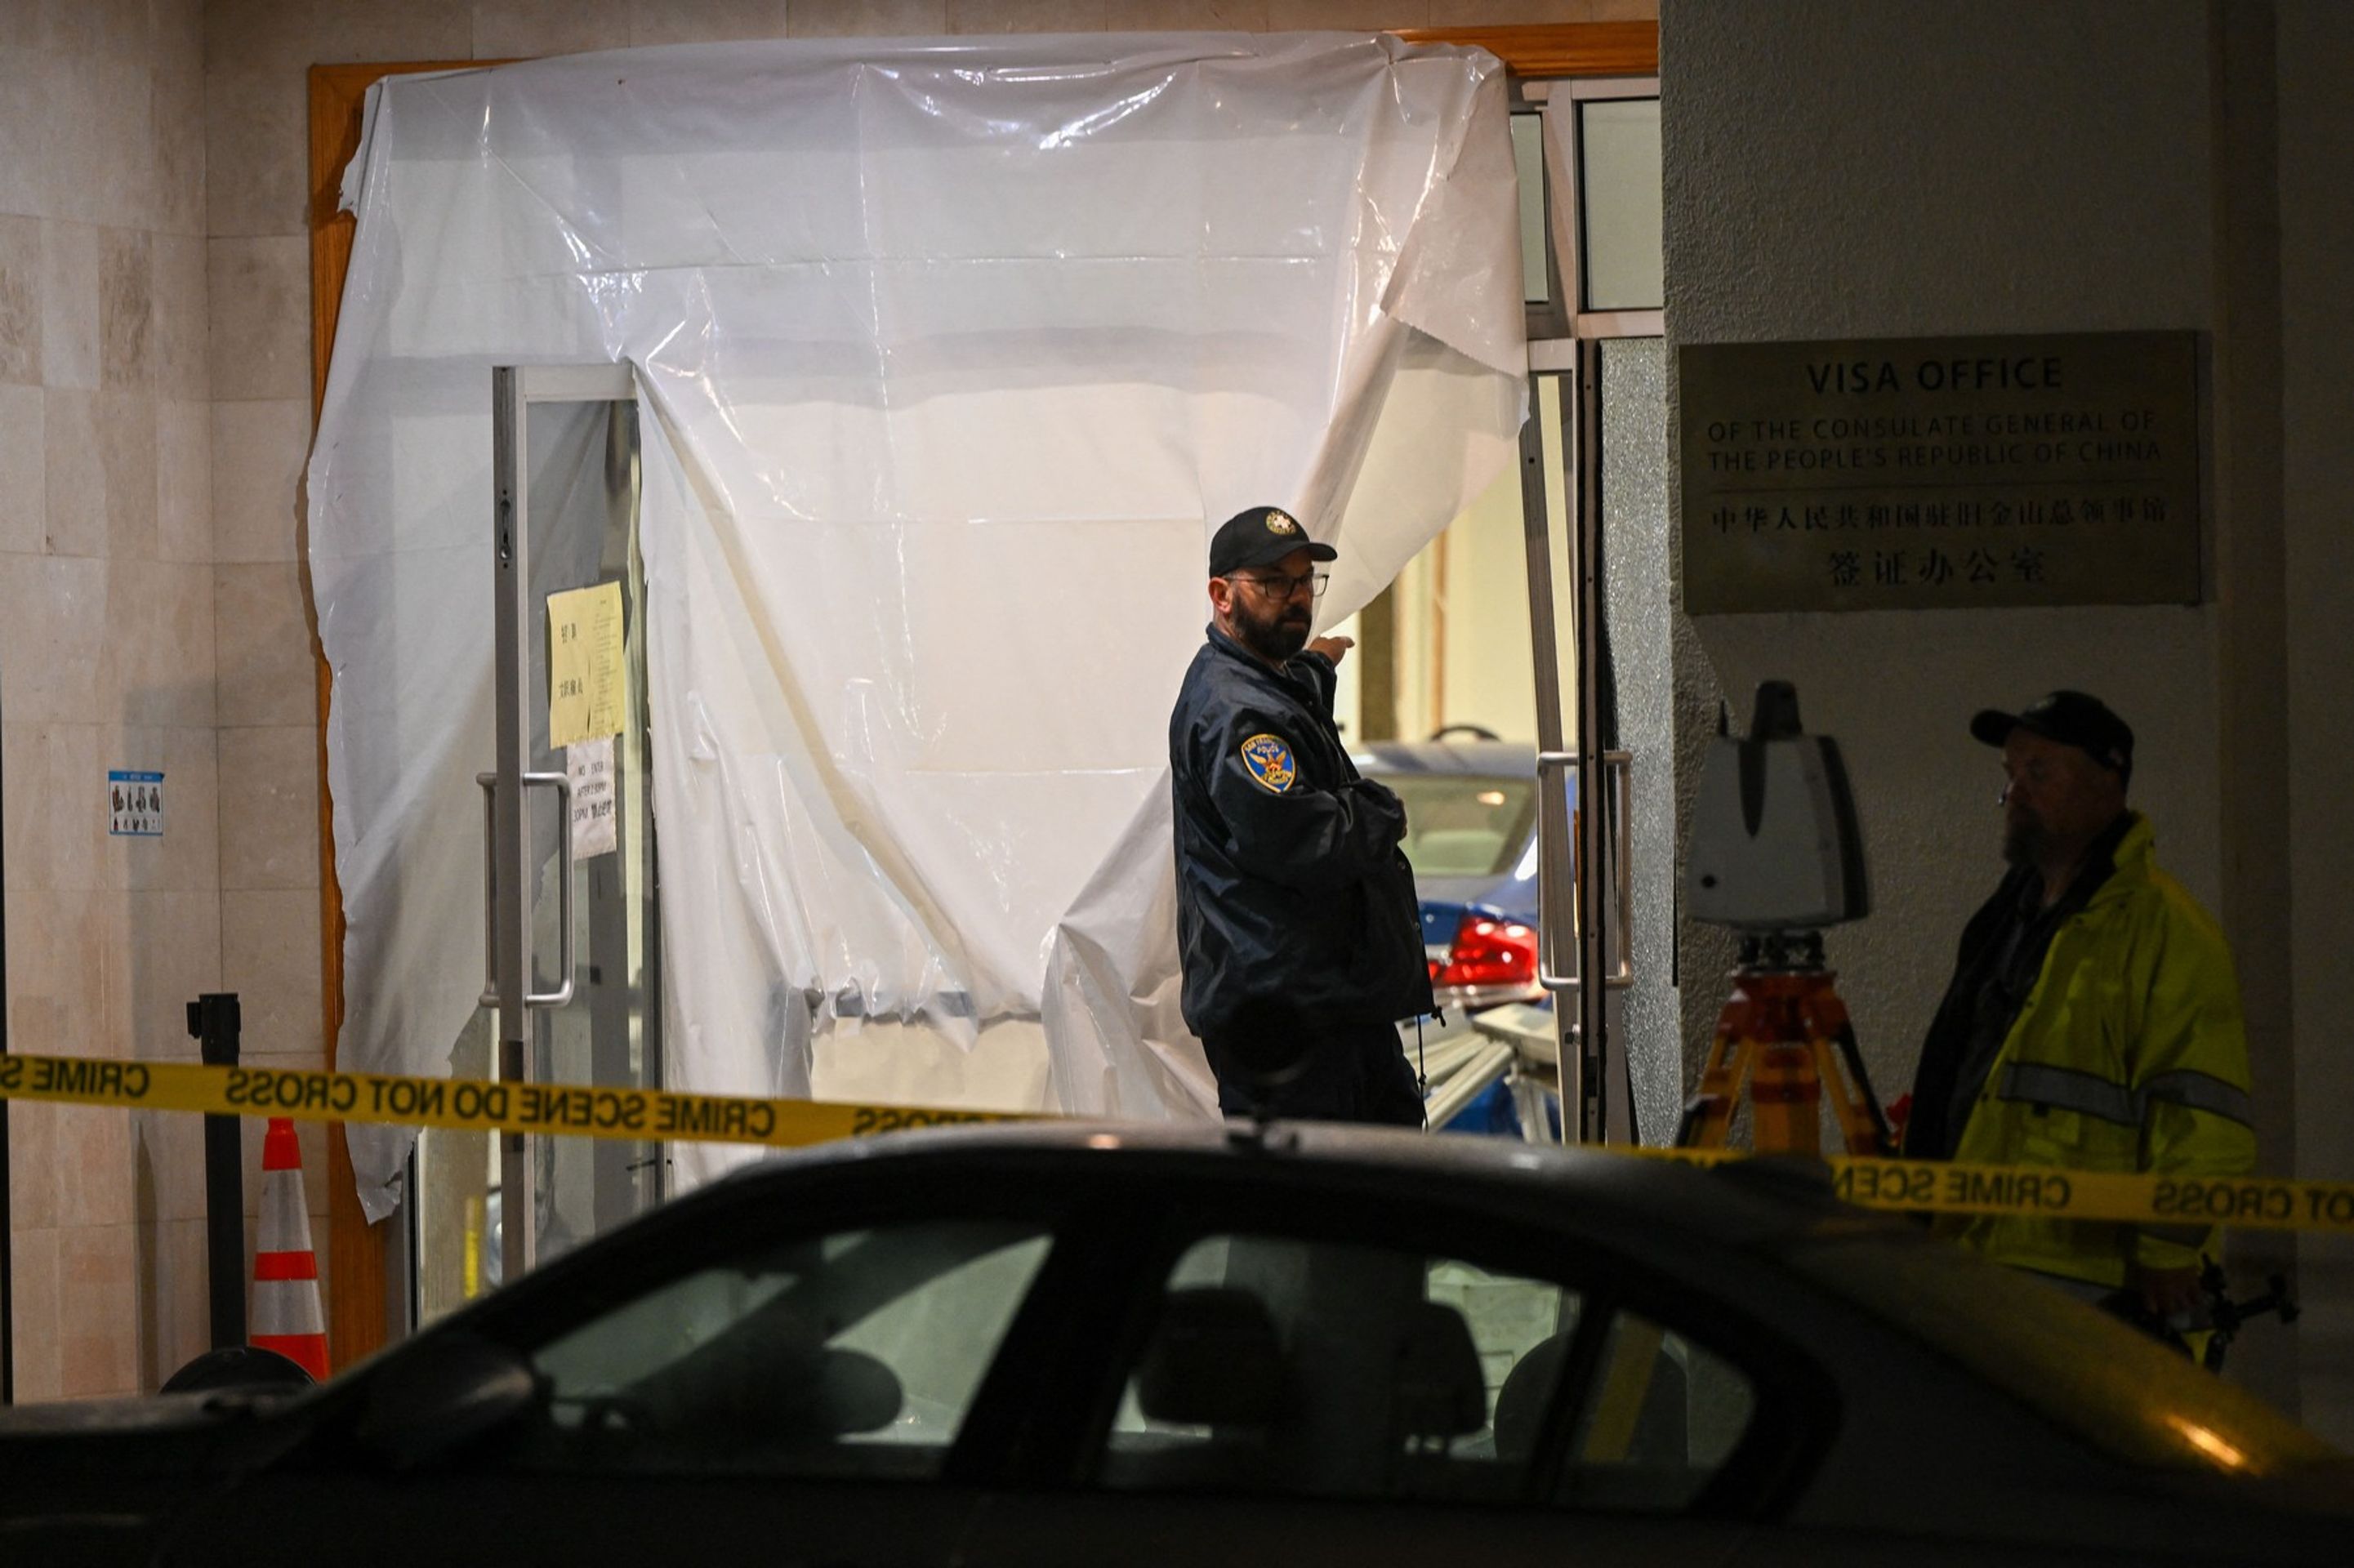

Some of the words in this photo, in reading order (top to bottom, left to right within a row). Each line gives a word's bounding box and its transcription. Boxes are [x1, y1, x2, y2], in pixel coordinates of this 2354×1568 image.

[1806, 361, 1900, 394] VISA
[1918, 356, 2062, 391] OFFICE
[1707, 421, 1741, 443] OF
[1751, 418, 1802, 441] THE
[1812, 414, 1975, 440] CONSULATE
[1986, 411, 2106, 436] GENERAL
[2120, 409, 2157, 431] OF
[1707, 450, 1757, 472] THE
[1768, 447, 1888, 470] PEOPLE'S
[1898, 443, 2026, 468] REPUBLIC
[2035, 442, 2070, 463] OF
[2079, 439, 2163, 462] CHINA
[1830, 546, 2045, 587] 签证办公室
